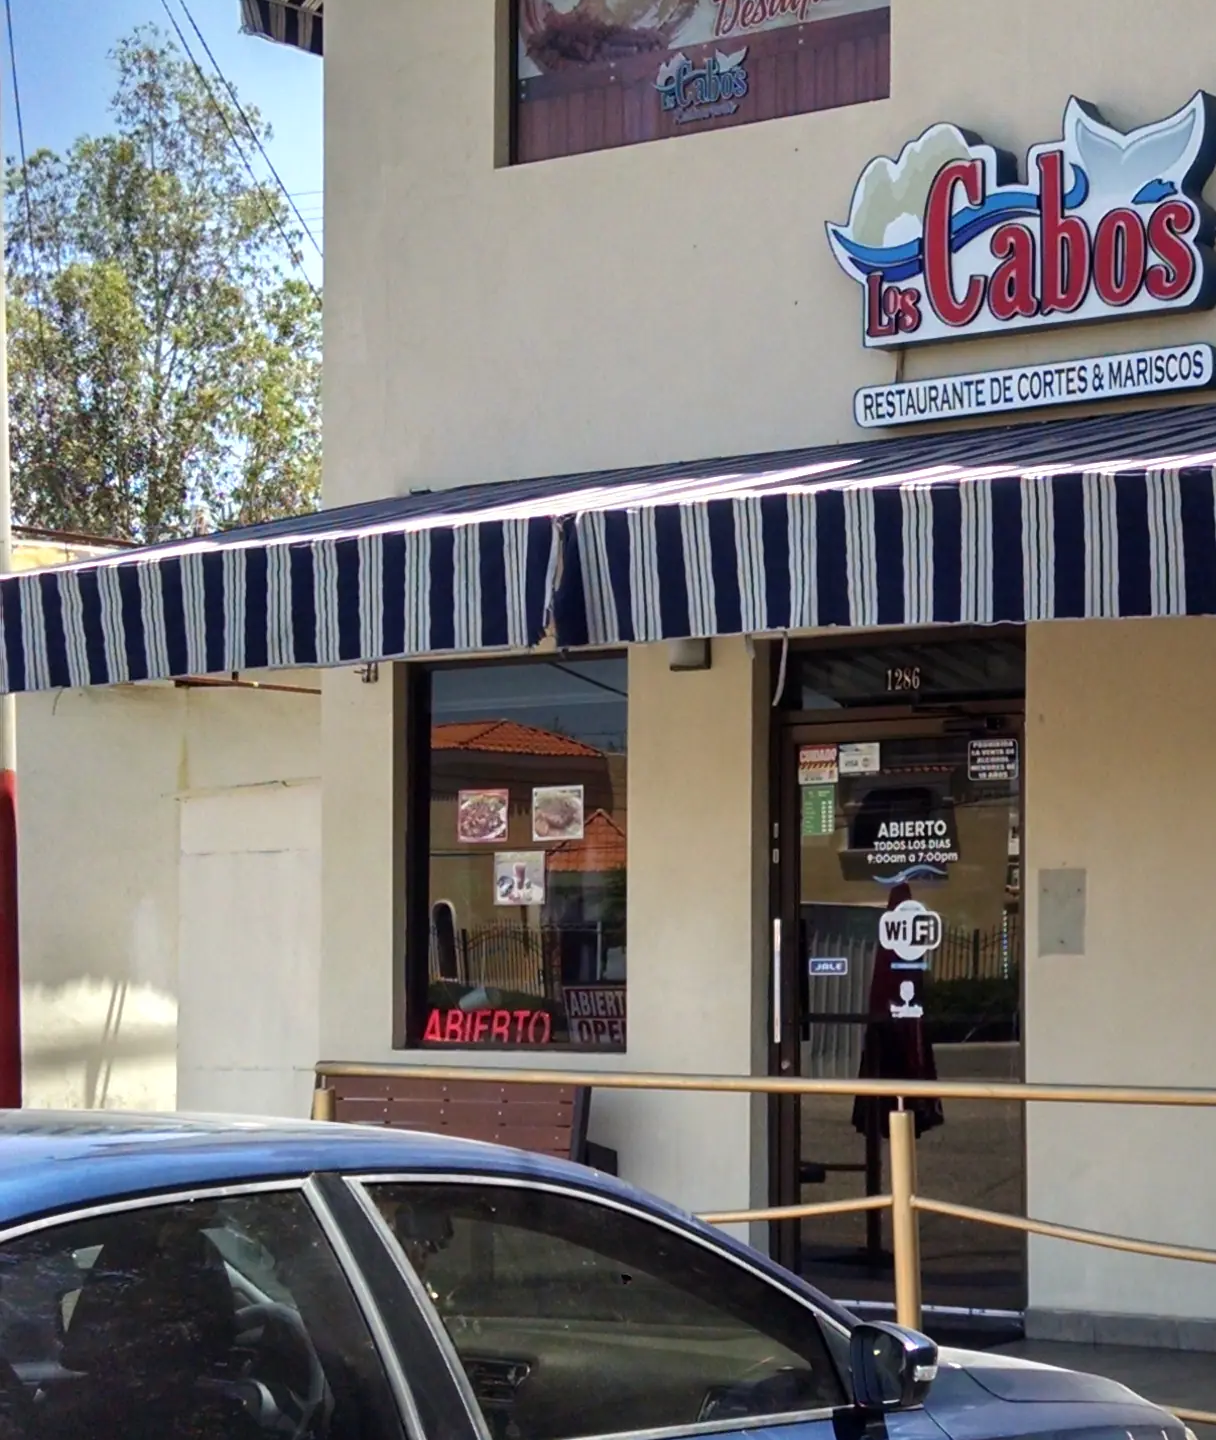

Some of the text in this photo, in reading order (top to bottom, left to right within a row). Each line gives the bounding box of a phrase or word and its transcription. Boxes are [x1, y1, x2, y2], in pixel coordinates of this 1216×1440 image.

[676, 57, 747, 108] Cabos
[866, 151, 1196, 337] Los Cabos
[863, 350, 1204, 422] RESTAURANTE DE CORTES & MARISCOS
[887, 667, 921, 691] 1286
[877, 820, 947, 838] ABIERTO
[873, 840, 906, 851] TODOS
[907, 839, 926, 850] LOS
[908, 854, 916, 862] a
[423, 1008, 551, 1044] ABIERTO
